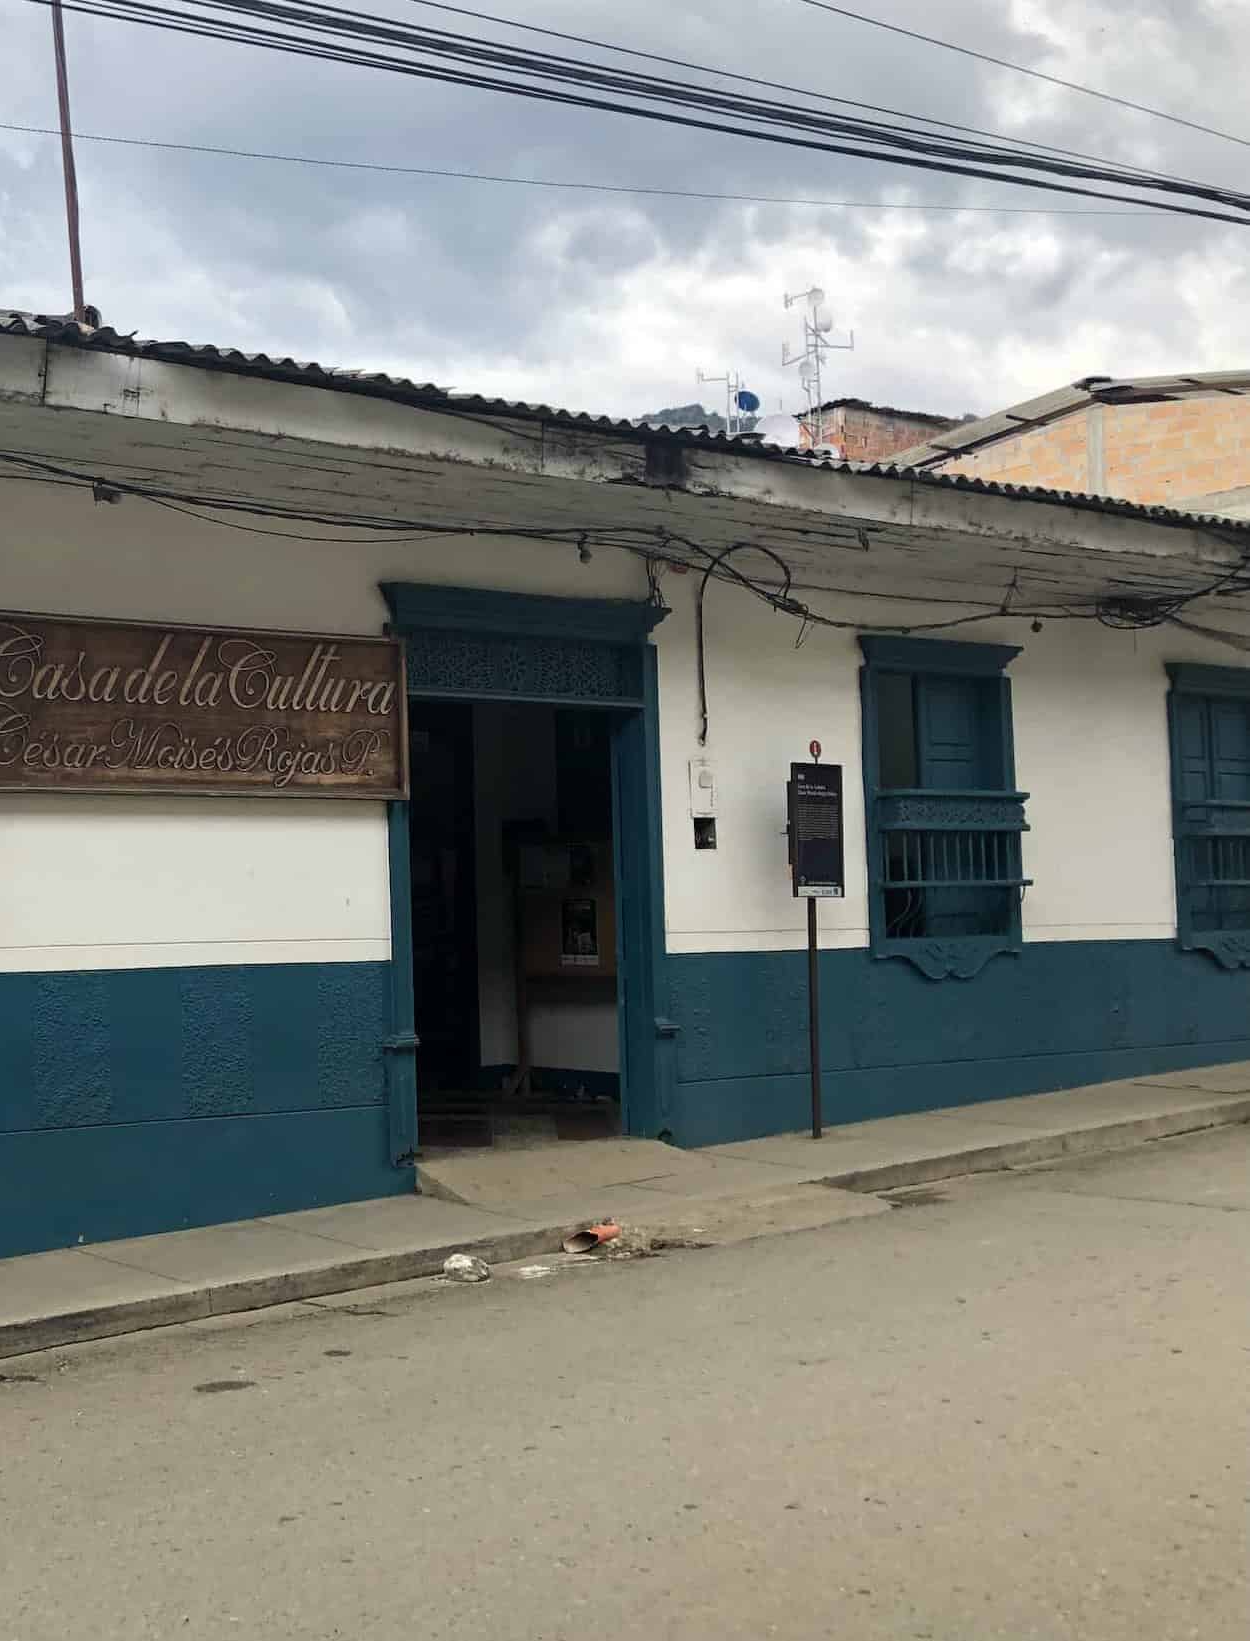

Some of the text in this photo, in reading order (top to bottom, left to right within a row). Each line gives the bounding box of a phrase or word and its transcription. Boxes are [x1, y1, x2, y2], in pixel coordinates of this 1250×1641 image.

[124, 633, 178, 706] de
[179, 636, 222, 707] la
[217, 639, 396, 715] Cultura
[233, 721, 338, 788] Rojas
